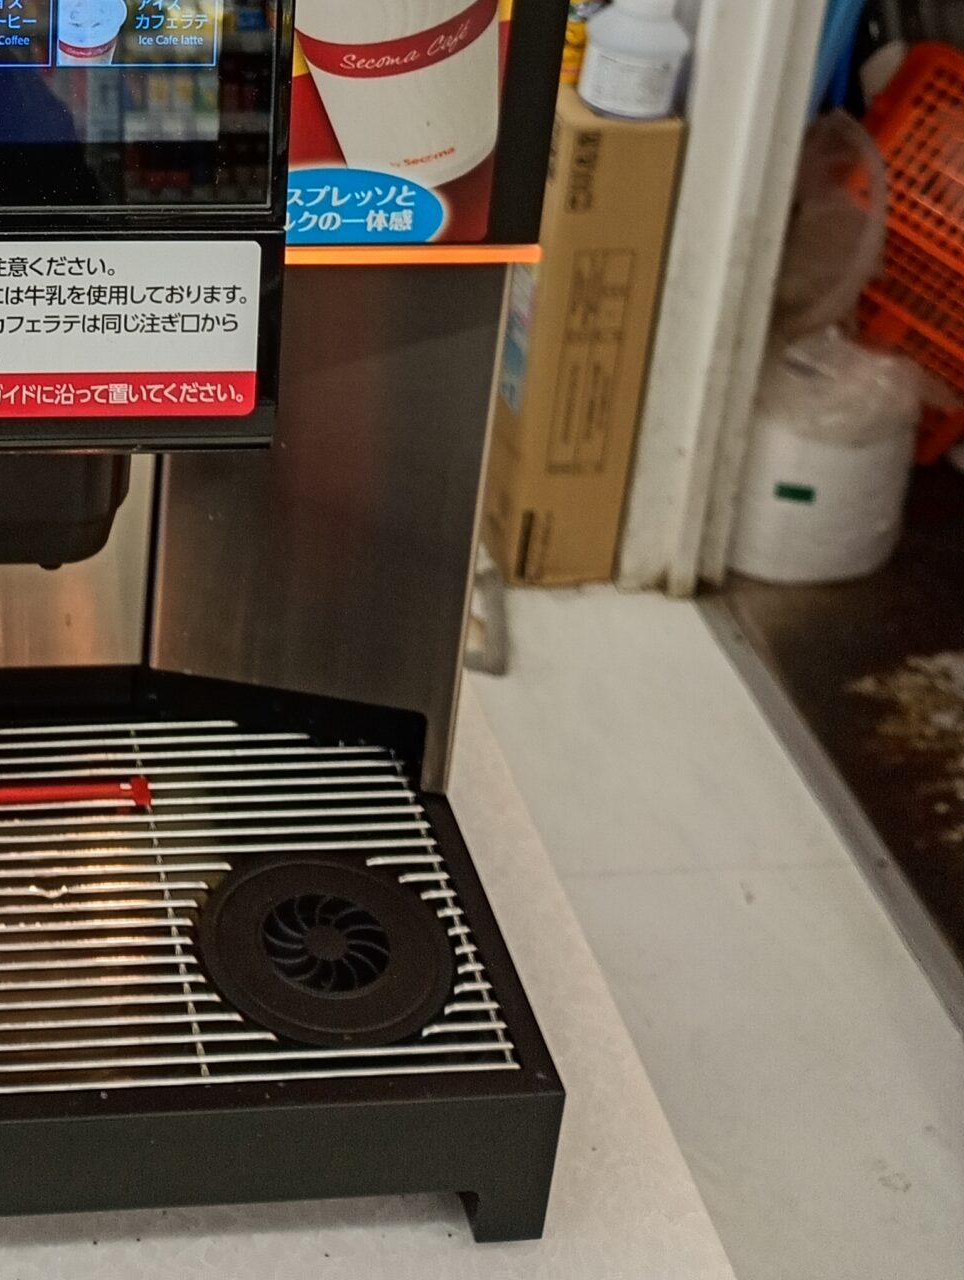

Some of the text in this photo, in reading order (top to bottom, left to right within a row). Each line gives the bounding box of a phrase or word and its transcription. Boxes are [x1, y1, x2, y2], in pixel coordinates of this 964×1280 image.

[136, 14, 209, 31] カフェラテ
[139, 34, 203, 46] Ice Cafe latte
[340, 51, 420, 70] Secoma
[287, 185, 416, 207] スプレッソと
